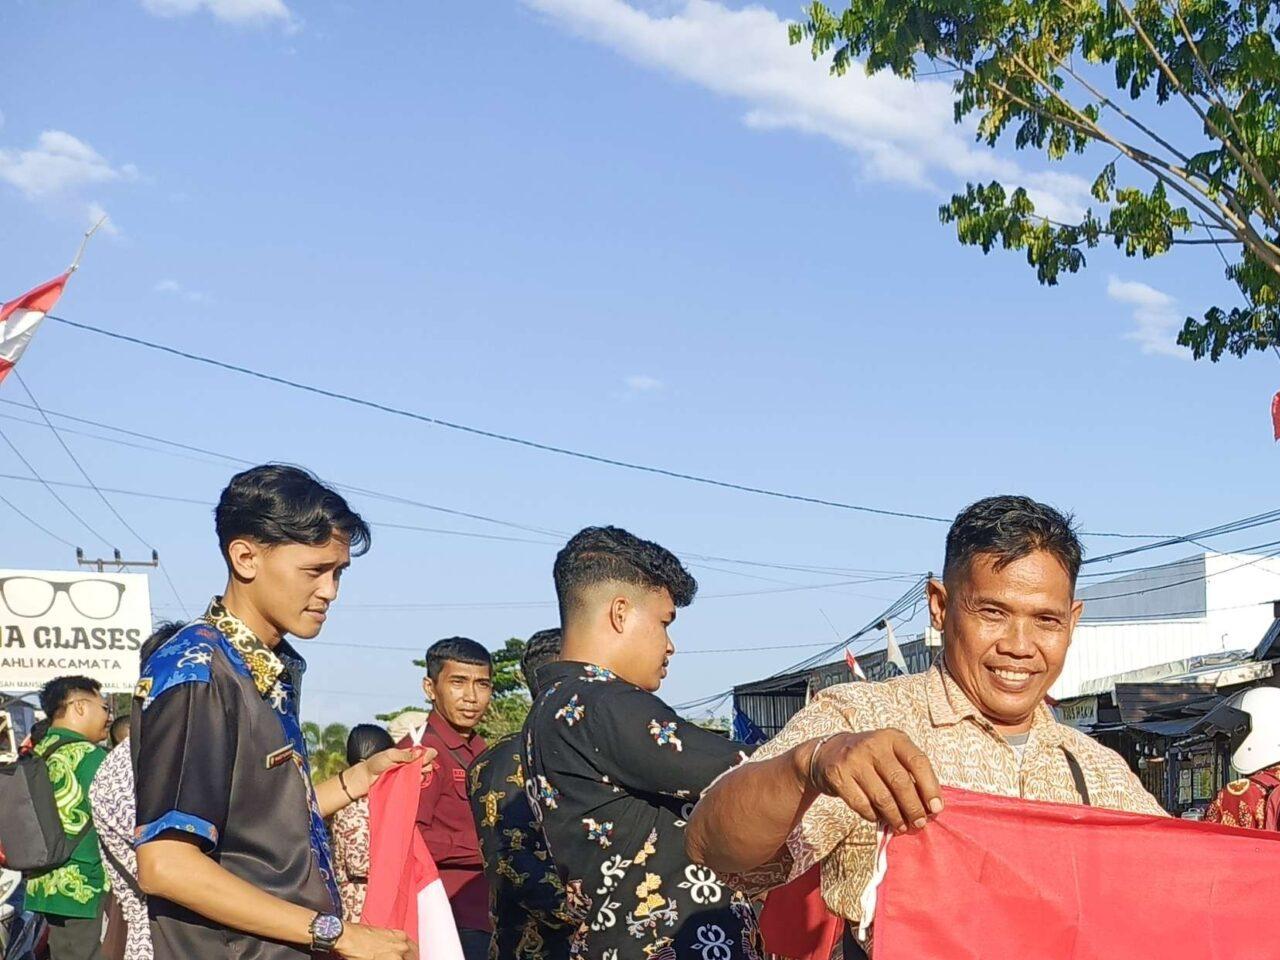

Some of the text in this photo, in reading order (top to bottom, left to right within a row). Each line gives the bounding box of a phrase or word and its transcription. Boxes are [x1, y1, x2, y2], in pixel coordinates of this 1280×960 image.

[33, 626, 141, 650] GLASES
[0, 658, 122, 670] AHLI KACAMATA
